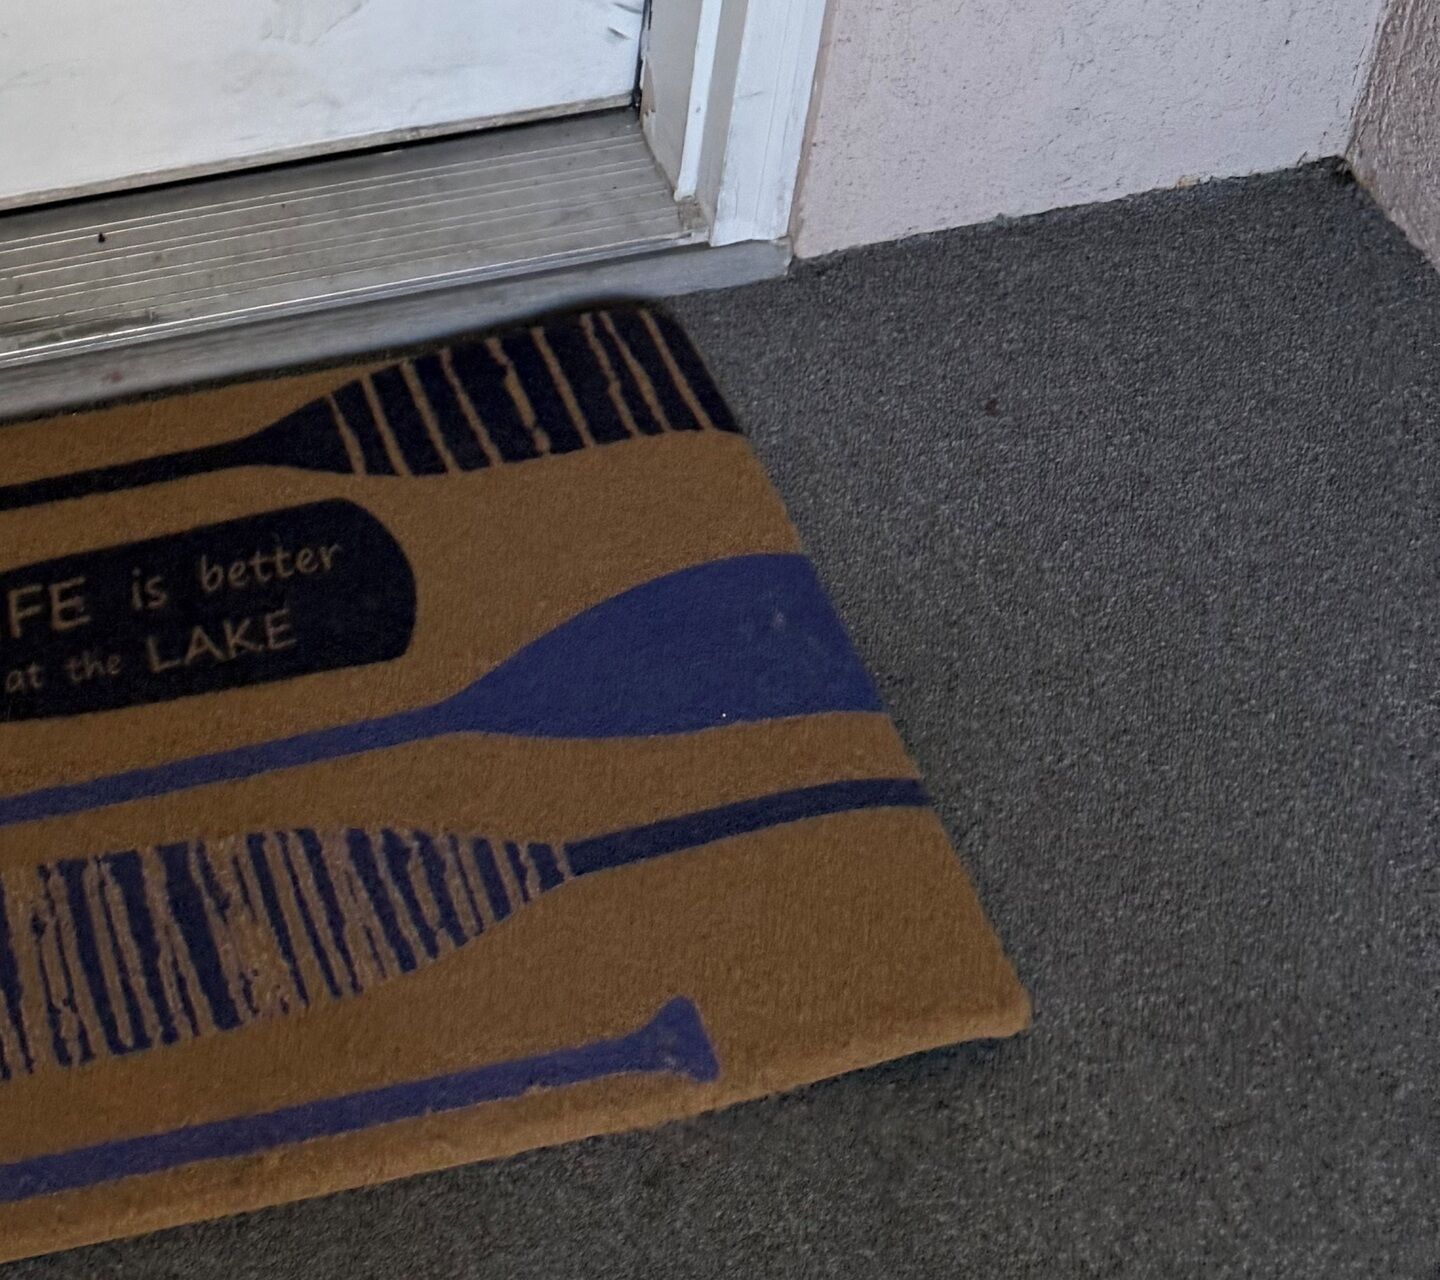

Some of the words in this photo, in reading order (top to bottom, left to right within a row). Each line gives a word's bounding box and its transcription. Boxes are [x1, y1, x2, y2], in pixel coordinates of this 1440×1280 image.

[130, 566, 168, 612] is
[198, 534, 343, 592] better
[4, 659, 44, 694] at
[65, 646, 123, 683] the
[145, 608, 299, 673] LAKE
